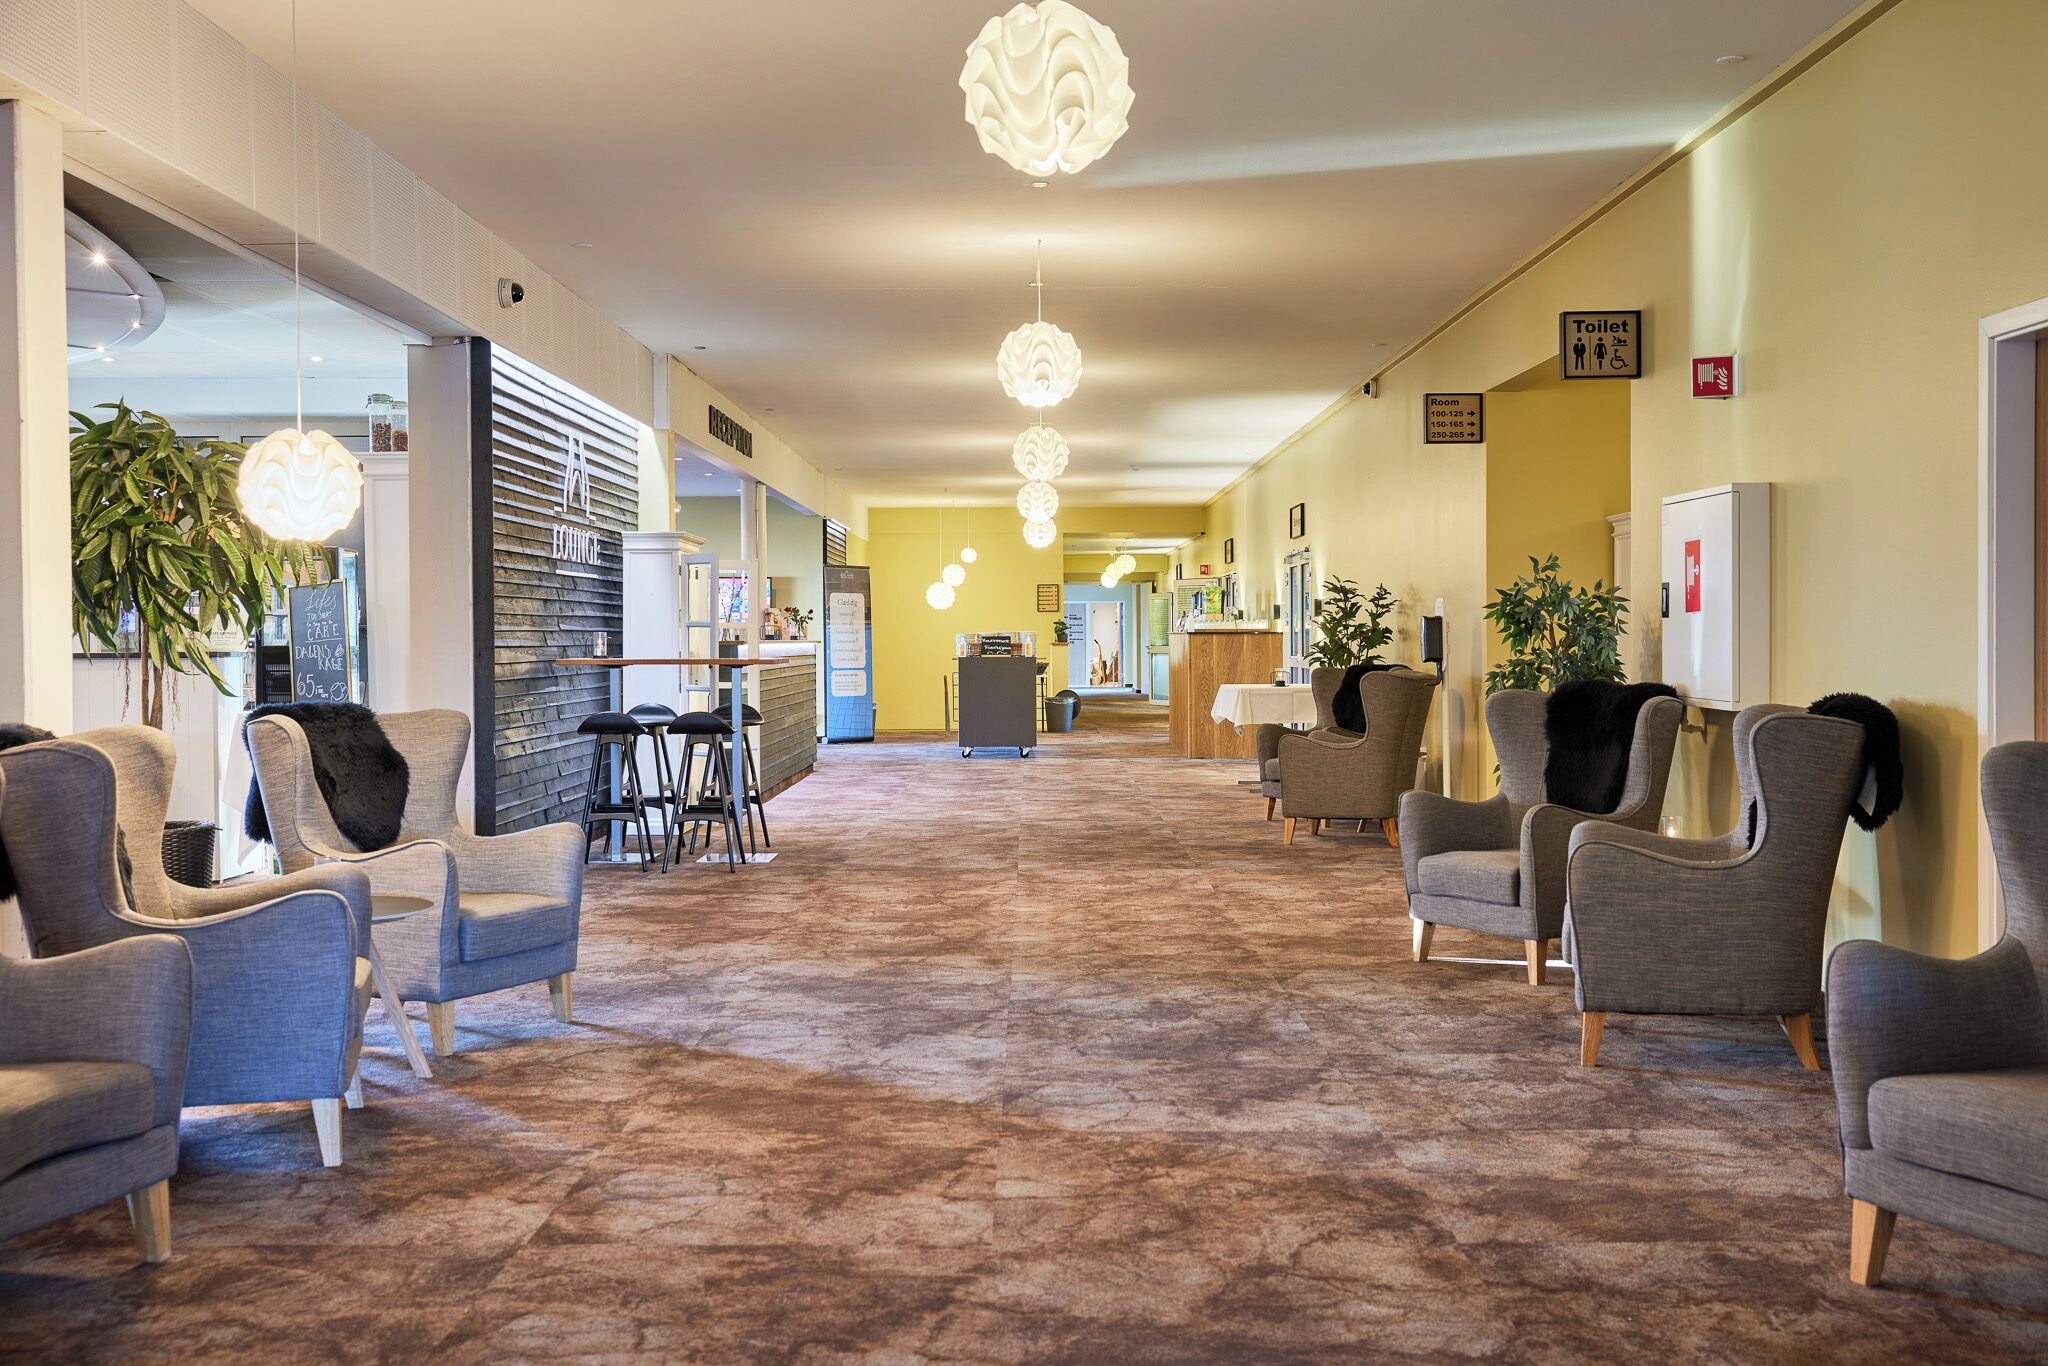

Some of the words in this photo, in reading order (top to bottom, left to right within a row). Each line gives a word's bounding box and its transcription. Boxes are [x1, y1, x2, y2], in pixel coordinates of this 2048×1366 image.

[1572, 319, 1629, 334] Toilet
[1430, 398, 1460, 406] Room
[708, 404, 753, 459] RECEPTION
[552, 523, 601, 565] LOUNGE
[307, 624, 340, 641] CAKE
[295, 644, 332, 660] DAGENS
[318, 658, 345, 671] KAGE
